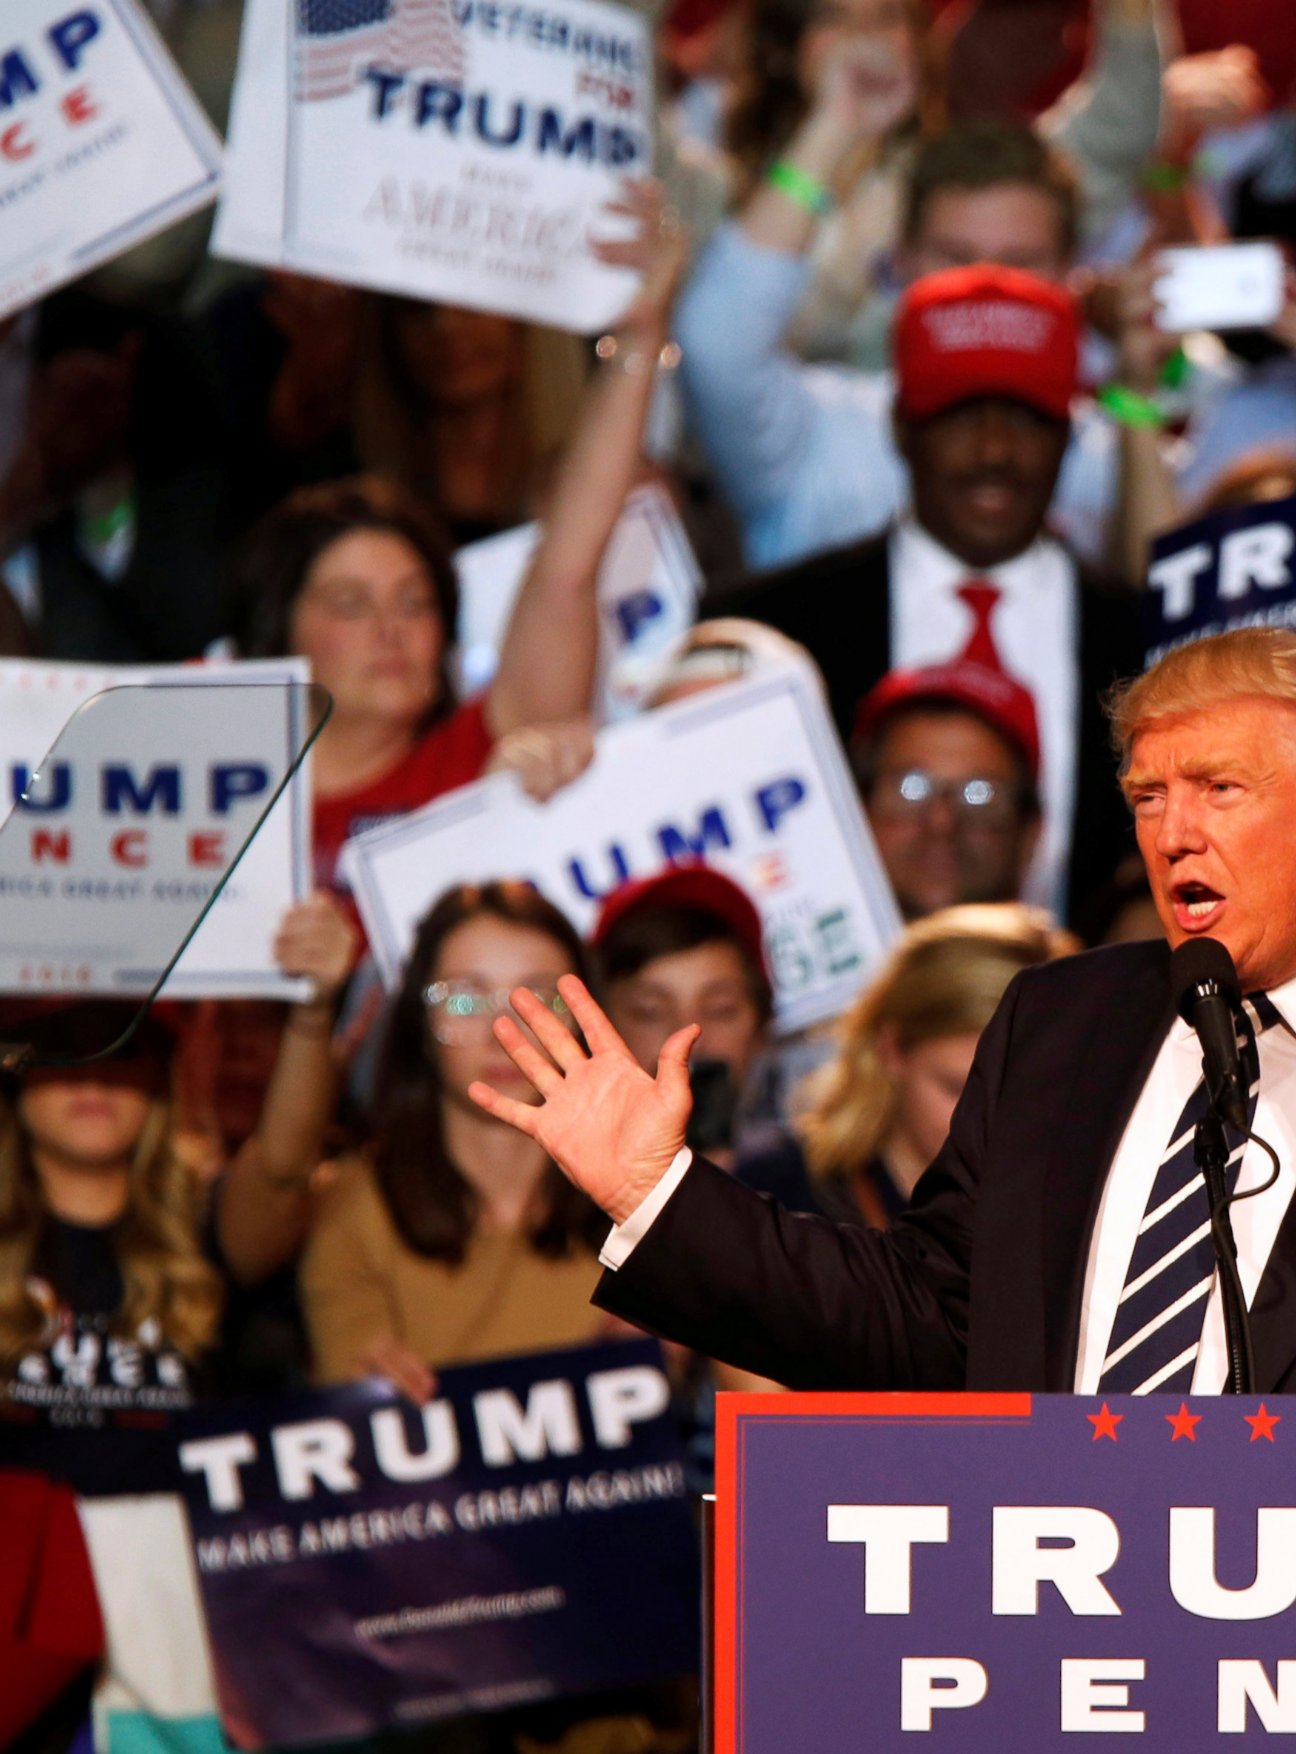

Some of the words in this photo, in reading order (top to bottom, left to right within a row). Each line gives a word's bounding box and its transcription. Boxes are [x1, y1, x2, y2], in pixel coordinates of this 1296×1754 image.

[358, 62, 638, 168] TRUMP
[560, 774, 807, 901] UMP
[178, 1365, 670, 1513] TRUMP
[200, 1523, 295, 1573] MAKE
[299, 1502, 452, 1554] AMERICA
[455, 1482, 561, 1530] GREAT
